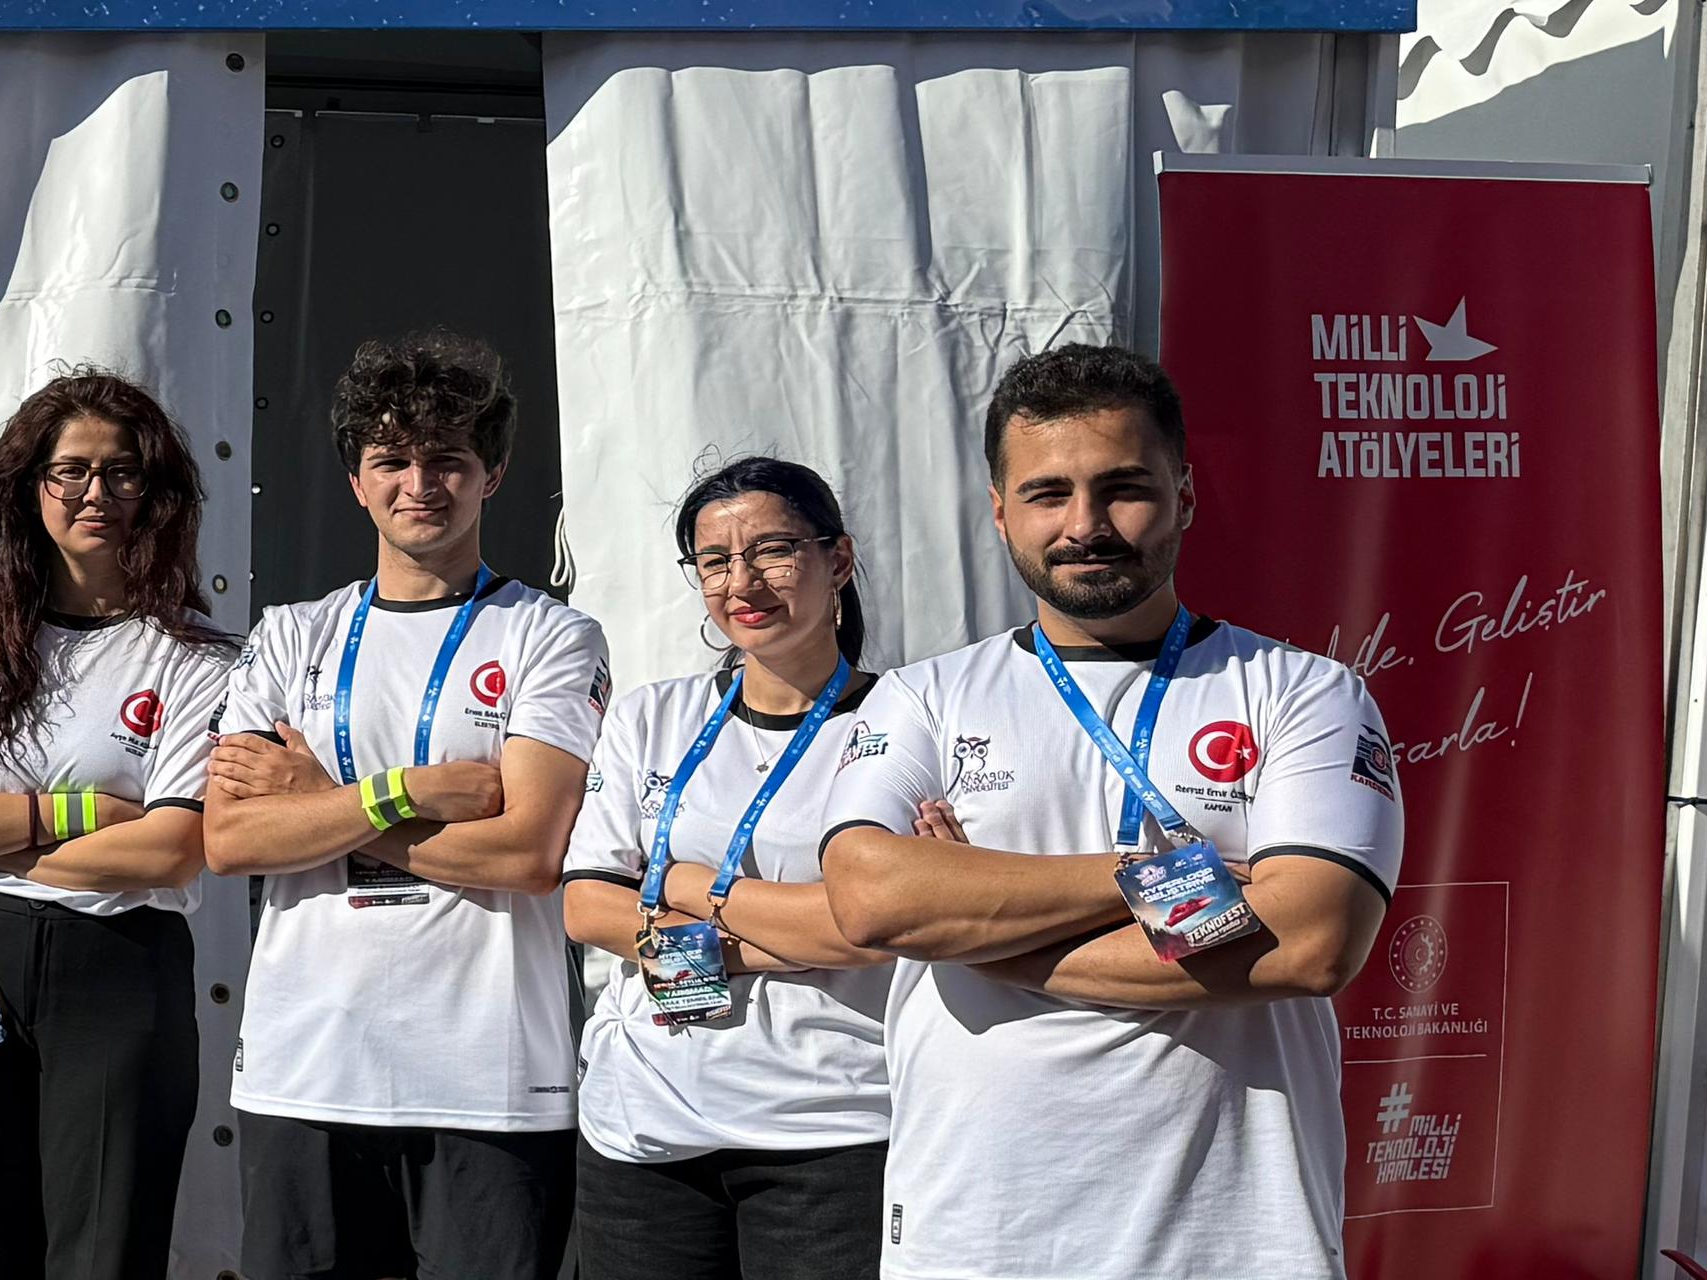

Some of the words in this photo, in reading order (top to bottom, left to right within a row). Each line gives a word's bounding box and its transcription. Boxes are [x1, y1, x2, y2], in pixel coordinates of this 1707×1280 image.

[1187, 902, 1248, 943] TEKNOFEST
[1372, 1007, 1396, 1020] T.C.
[1399, 1001, 1438, 1019] SANAYİ
[1441, 1003, 1459, 1016] VE
[1418, 1018, 1488, 1035] BAKANLIĞI
